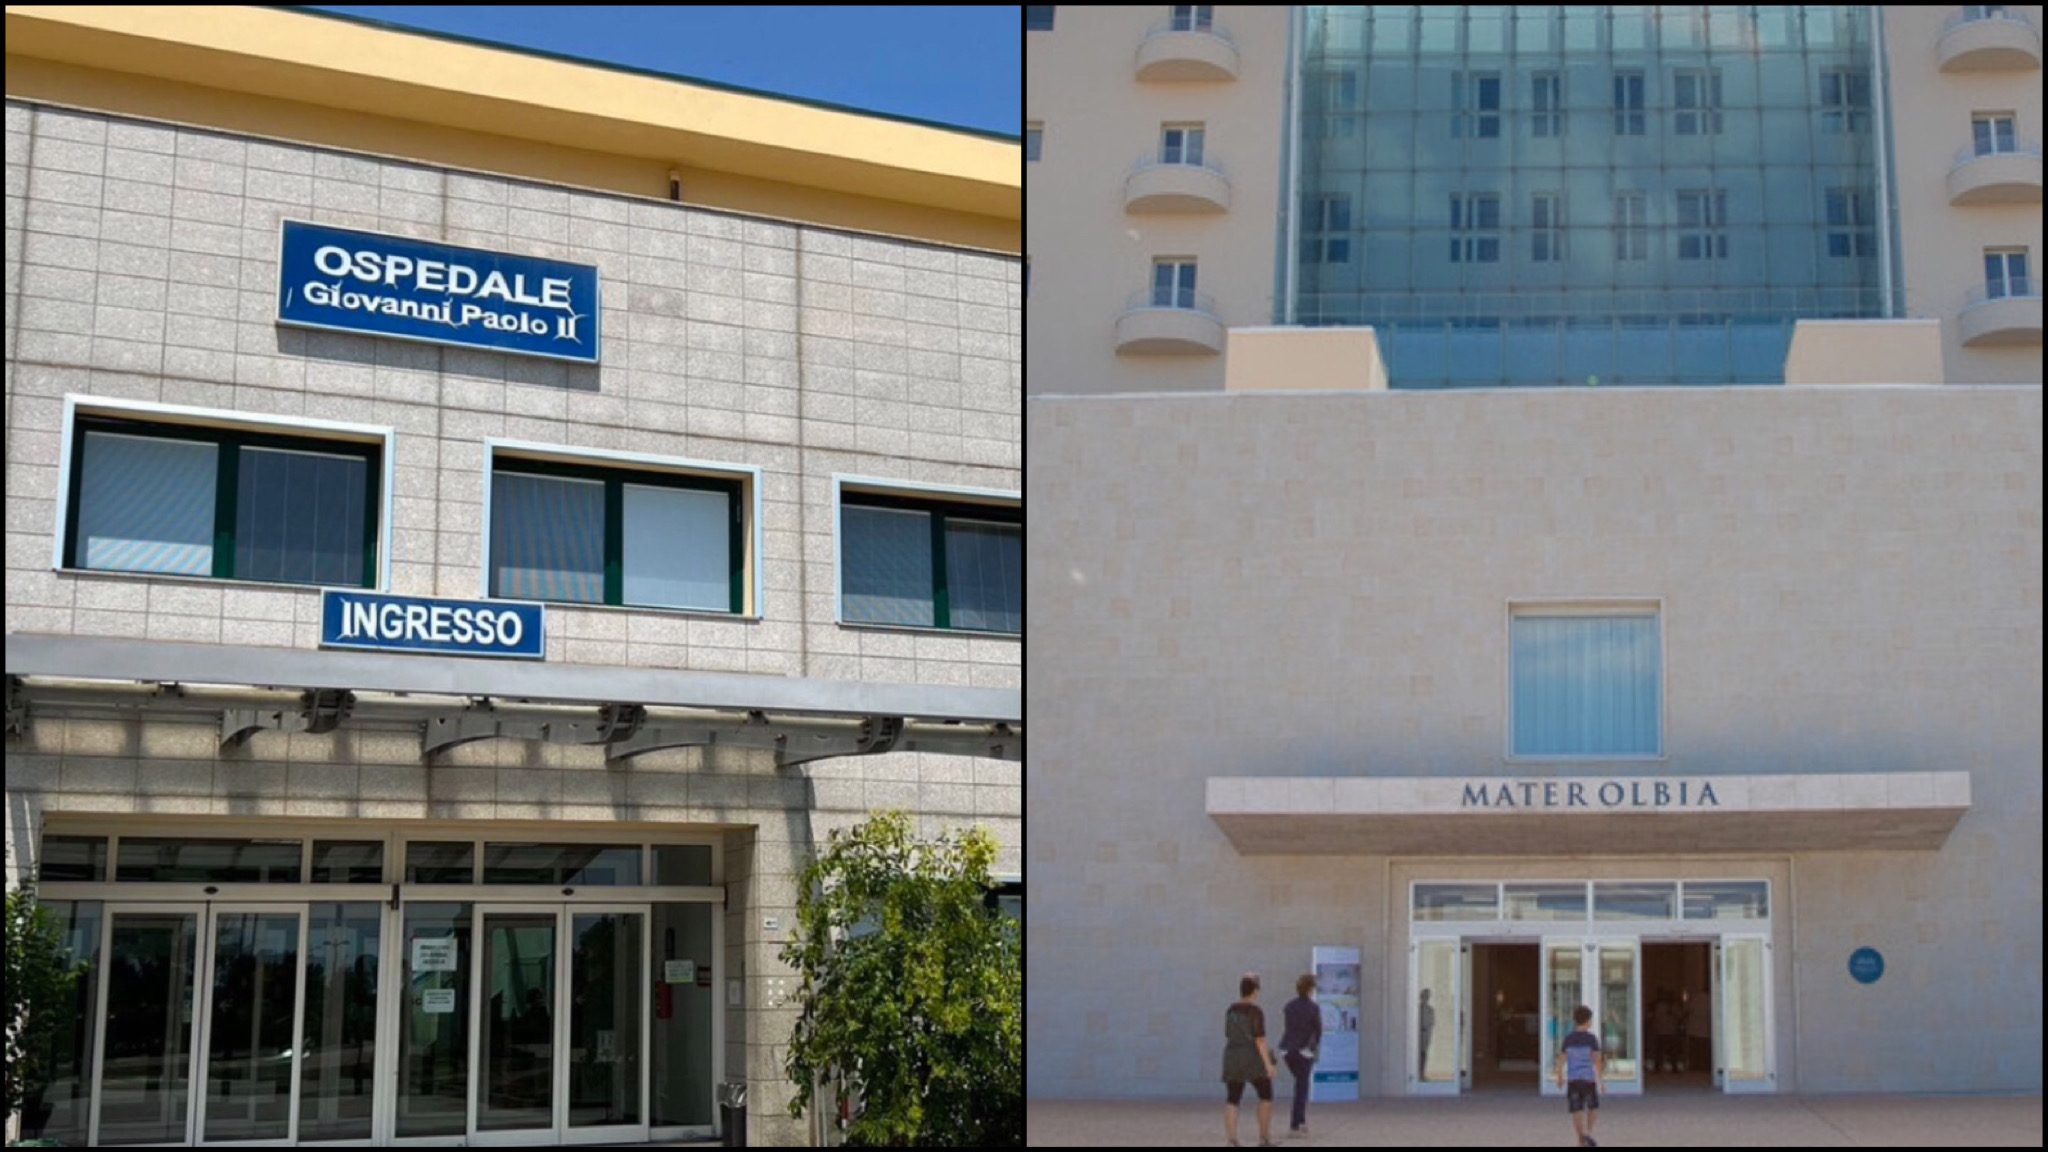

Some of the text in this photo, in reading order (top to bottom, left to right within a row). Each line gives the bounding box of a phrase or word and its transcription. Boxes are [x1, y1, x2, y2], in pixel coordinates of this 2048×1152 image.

[314, 245, 571, 308] OSPEDALE
[304, 281, 579, 340] Giovanni Paolo II
[342, 601, 523, 647] INGRESSO
[1461, 781, 1719, 807] MATER OLBIA
